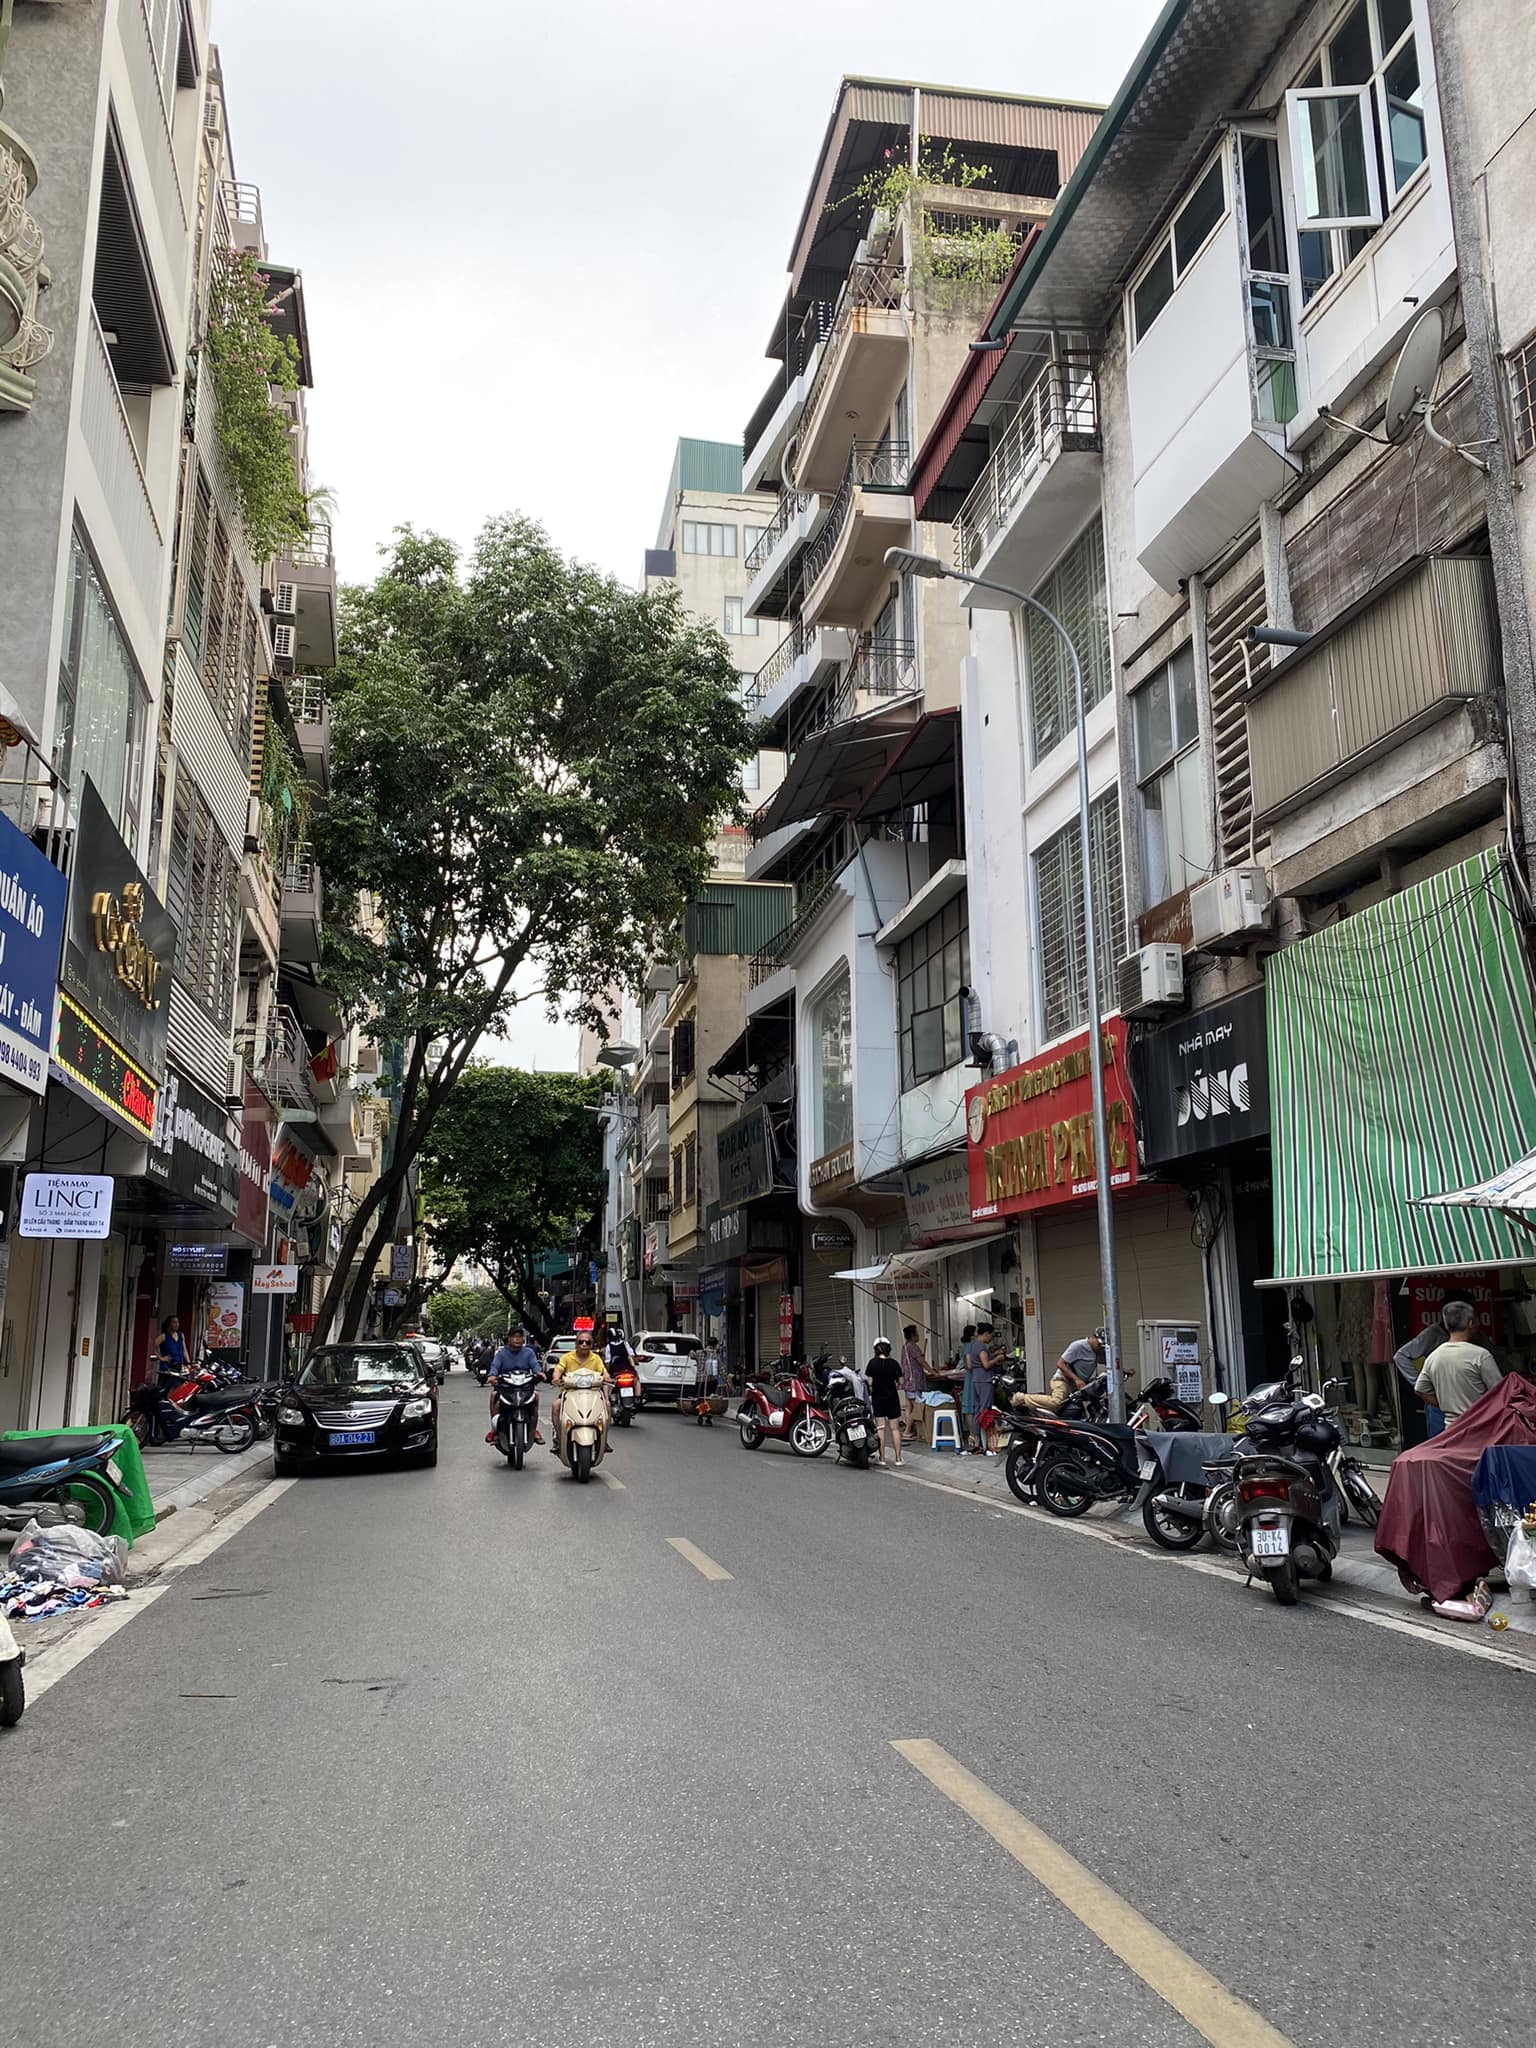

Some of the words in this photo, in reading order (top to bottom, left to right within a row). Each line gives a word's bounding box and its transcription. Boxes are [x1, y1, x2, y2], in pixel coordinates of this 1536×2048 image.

[0, 870, 27, 925] UẦN
[26, 893, 44, 938] ÁO
[1178, 1032, 1203, 1057] NHÀ
[1205, 1022, 1233, 1046] MAY
[1173, 1061, 1251, 1127] DŨNG
[985, 1130, 1050, 1202] MINH
[70, 1180, 90, 1188] MAY
[35, 1189, 99, 1209] LINCI
[1256, 1531, 1283, 1543] 30-K4
[1257, 1542, 1284, 1554] 0014
